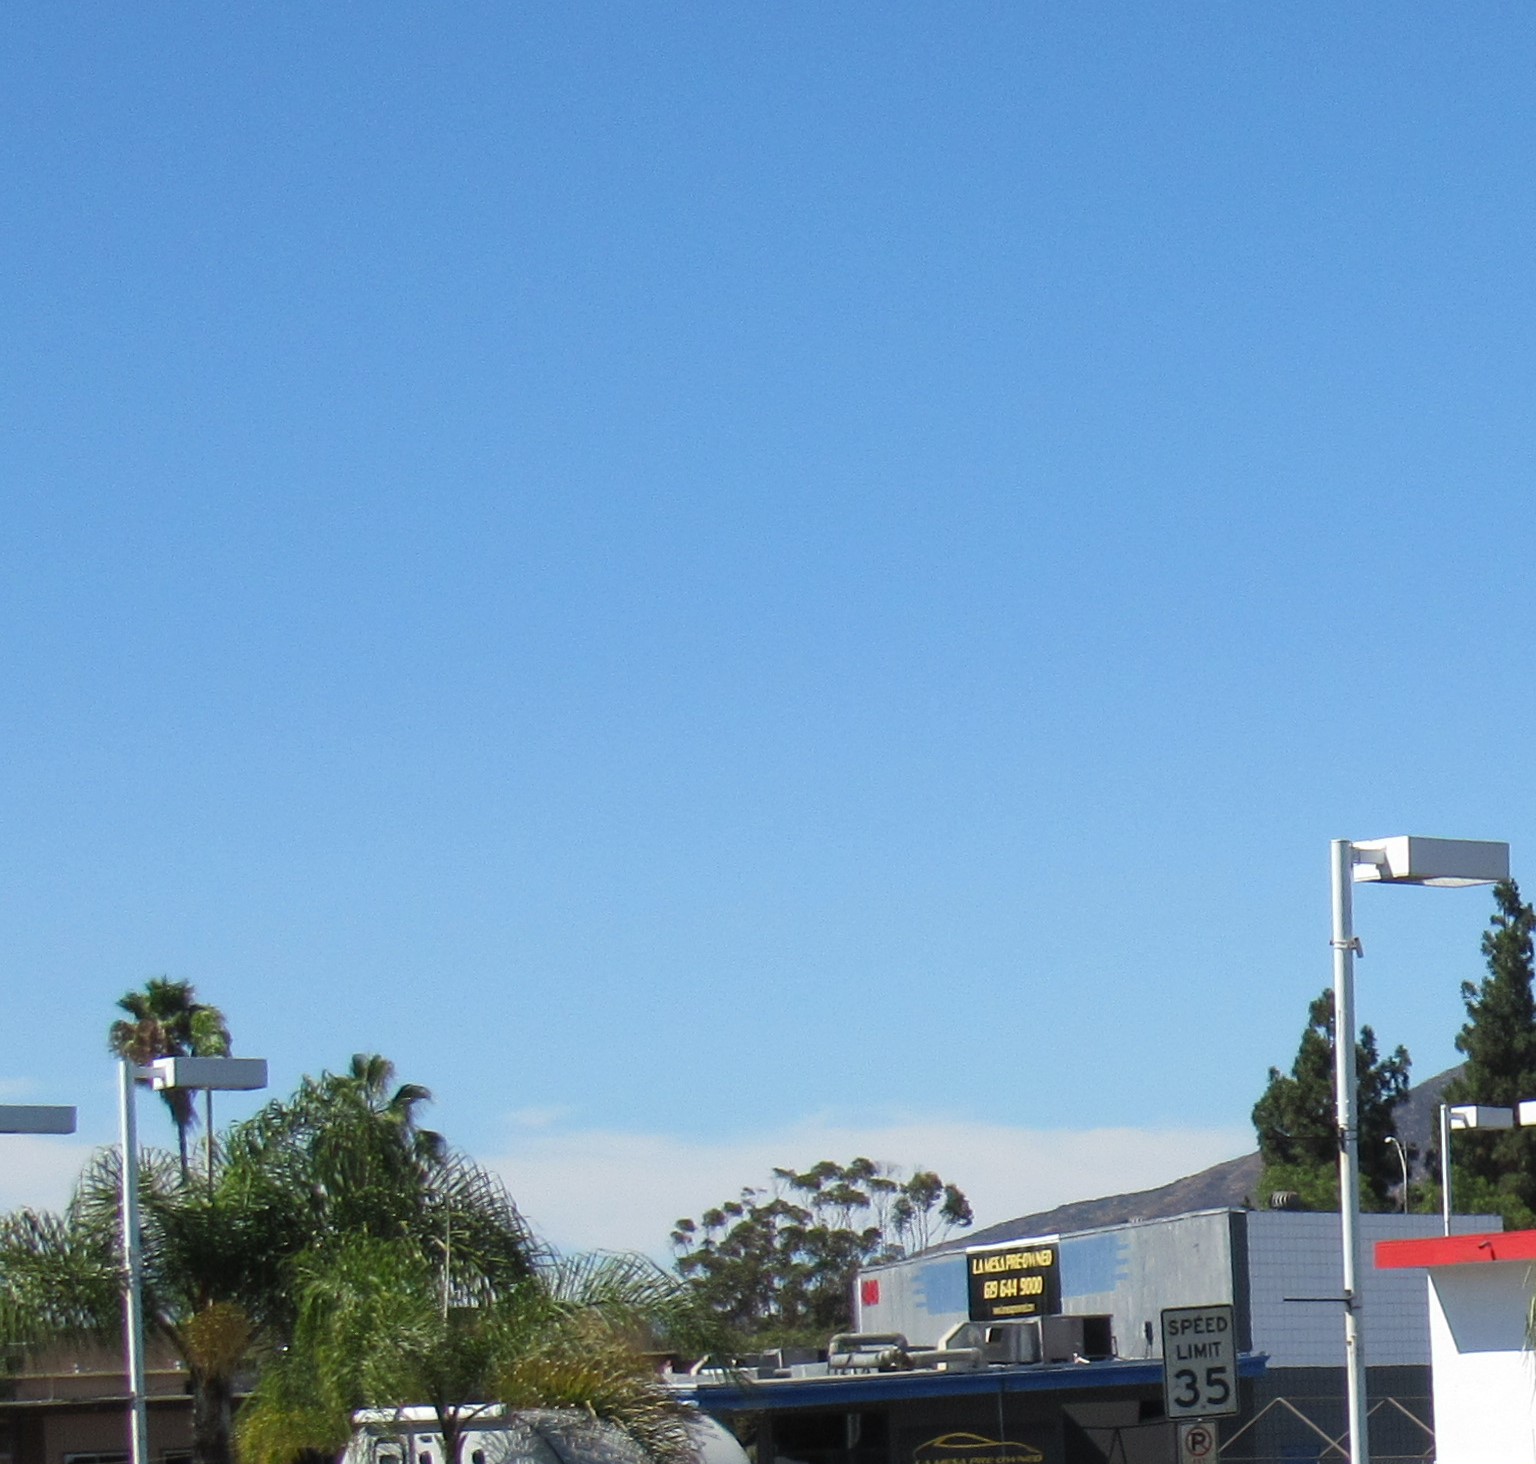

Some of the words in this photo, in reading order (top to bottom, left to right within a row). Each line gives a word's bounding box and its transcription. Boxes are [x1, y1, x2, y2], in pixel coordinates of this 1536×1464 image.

[973, 1258, 984, 1275] LA
[984, 1255, 1005, 1274] MESA
[983, 1280, 998, 1299] 619
[999, 1278, 1018, 1298] 644
[1019, 1275, 1043, 1296] 9000
[1168, 1316, 1228, 1336] SPEED
[1176, 1341, 1222, 1360] LIMIT
[1174, 1366, 1231, 1408] 35
